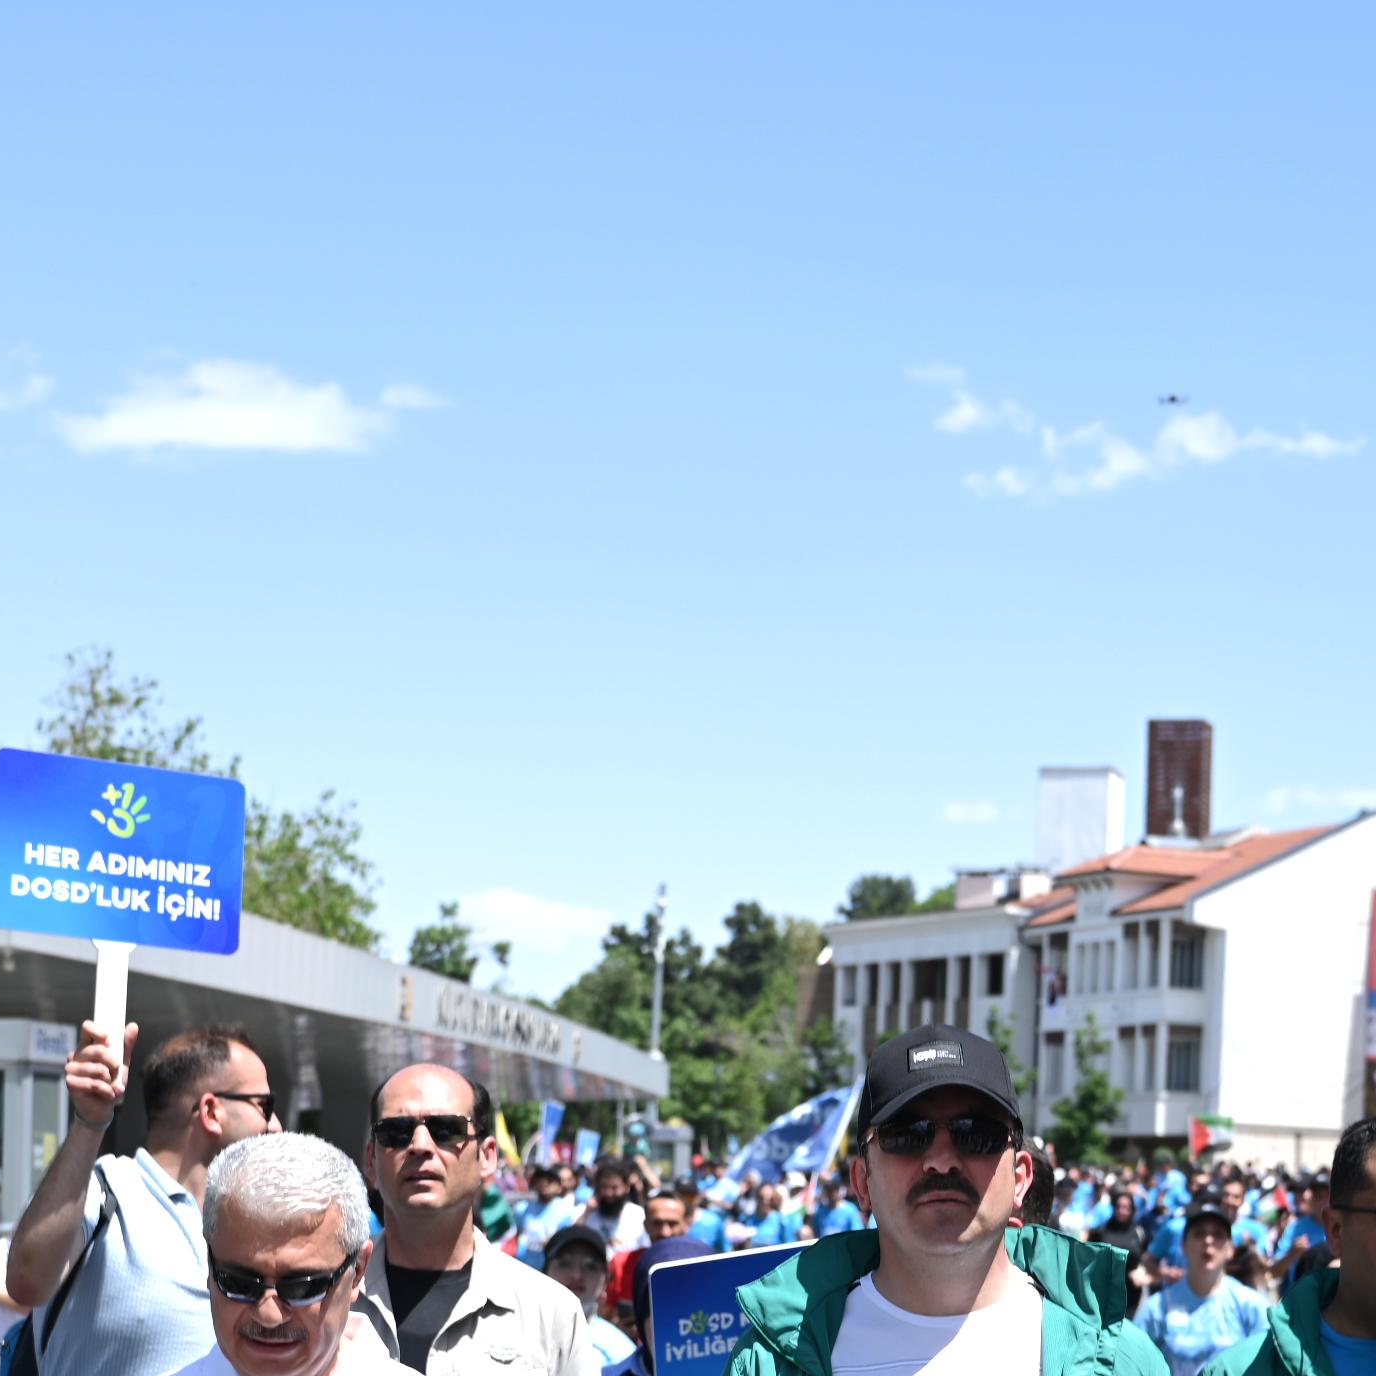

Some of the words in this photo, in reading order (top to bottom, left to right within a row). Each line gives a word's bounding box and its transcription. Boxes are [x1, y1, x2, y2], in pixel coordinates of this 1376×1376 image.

[24, 842, 80, 871] HER
[87, 851, 211, 887] ADIMINIZ
[157, 885, 221, 921] İÇİN!
